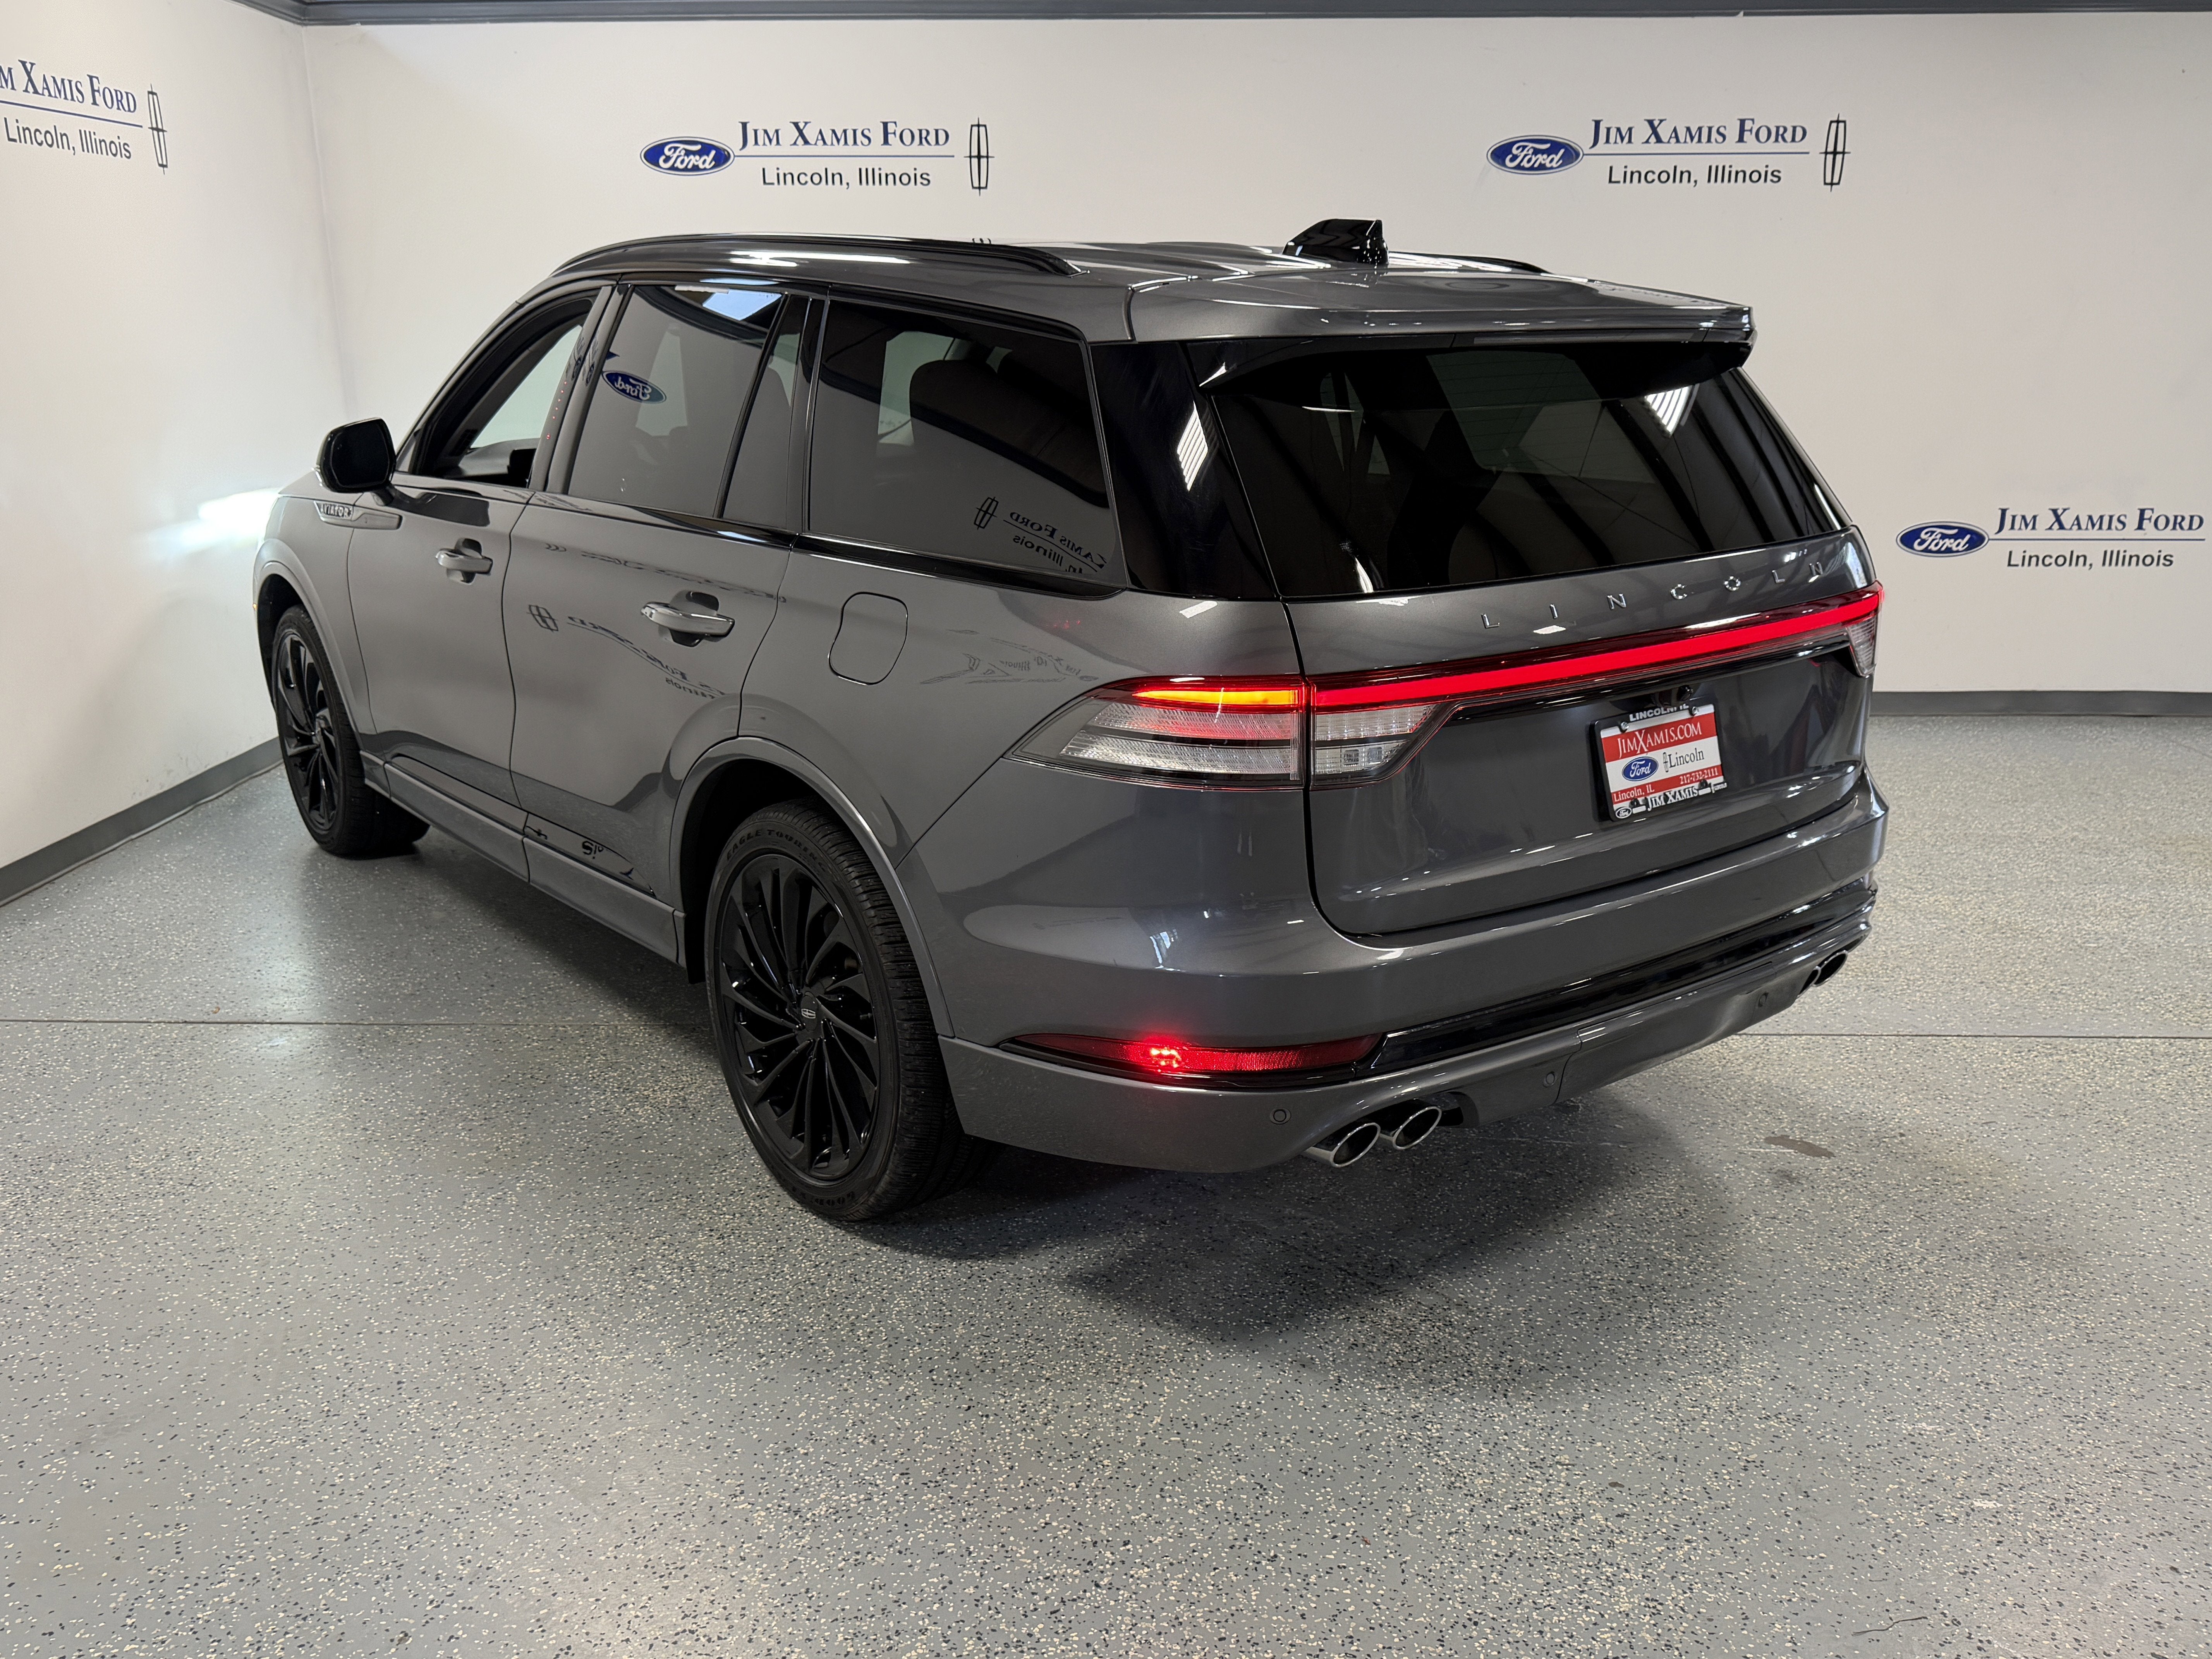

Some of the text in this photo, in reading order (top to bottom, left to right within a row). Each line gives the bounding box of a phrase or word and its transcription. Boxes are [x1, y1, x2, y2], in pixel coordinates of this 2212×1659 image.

[18, 59, 85, 104] XAMIS
[86, 74, 137, 113] FORD
[4, 117, 131, 160] Lincoln, Illinois
[739, 121, 950, 151] JIM XAMIS FORD
[1589, 118, 1807, 149] JIM XAMIS FORD
[658, 143, 716, 169] Ford
[1505, 142, 1565, 168] Ford
[762, 167, 931, 189] Lincoln, Illinois
[1608, 165, 1782, 187] Lincoln, Illinois
[1994, 508, 2205, 535] JIM XAMIS FORD
[1913, 527, 1971, 551] Ford
[2007, 550, 2174, 570] Lincoln, Illinois
[1481, 561, 1824, 629] LINCOLN
[1617, 721, 1702, 759] JIMXAMIS.COM
[1630, 760, 1650, 777] Ford
[1668, 748, 1704, 768] Lincoln
[1646, 785, 1654, 793] IL
[1680, 768, 1718, 785] 217-732-2111
[1647, 787, 1698, 811] JIM XAMIS
[726, 829, 763, 860] EAGLE
